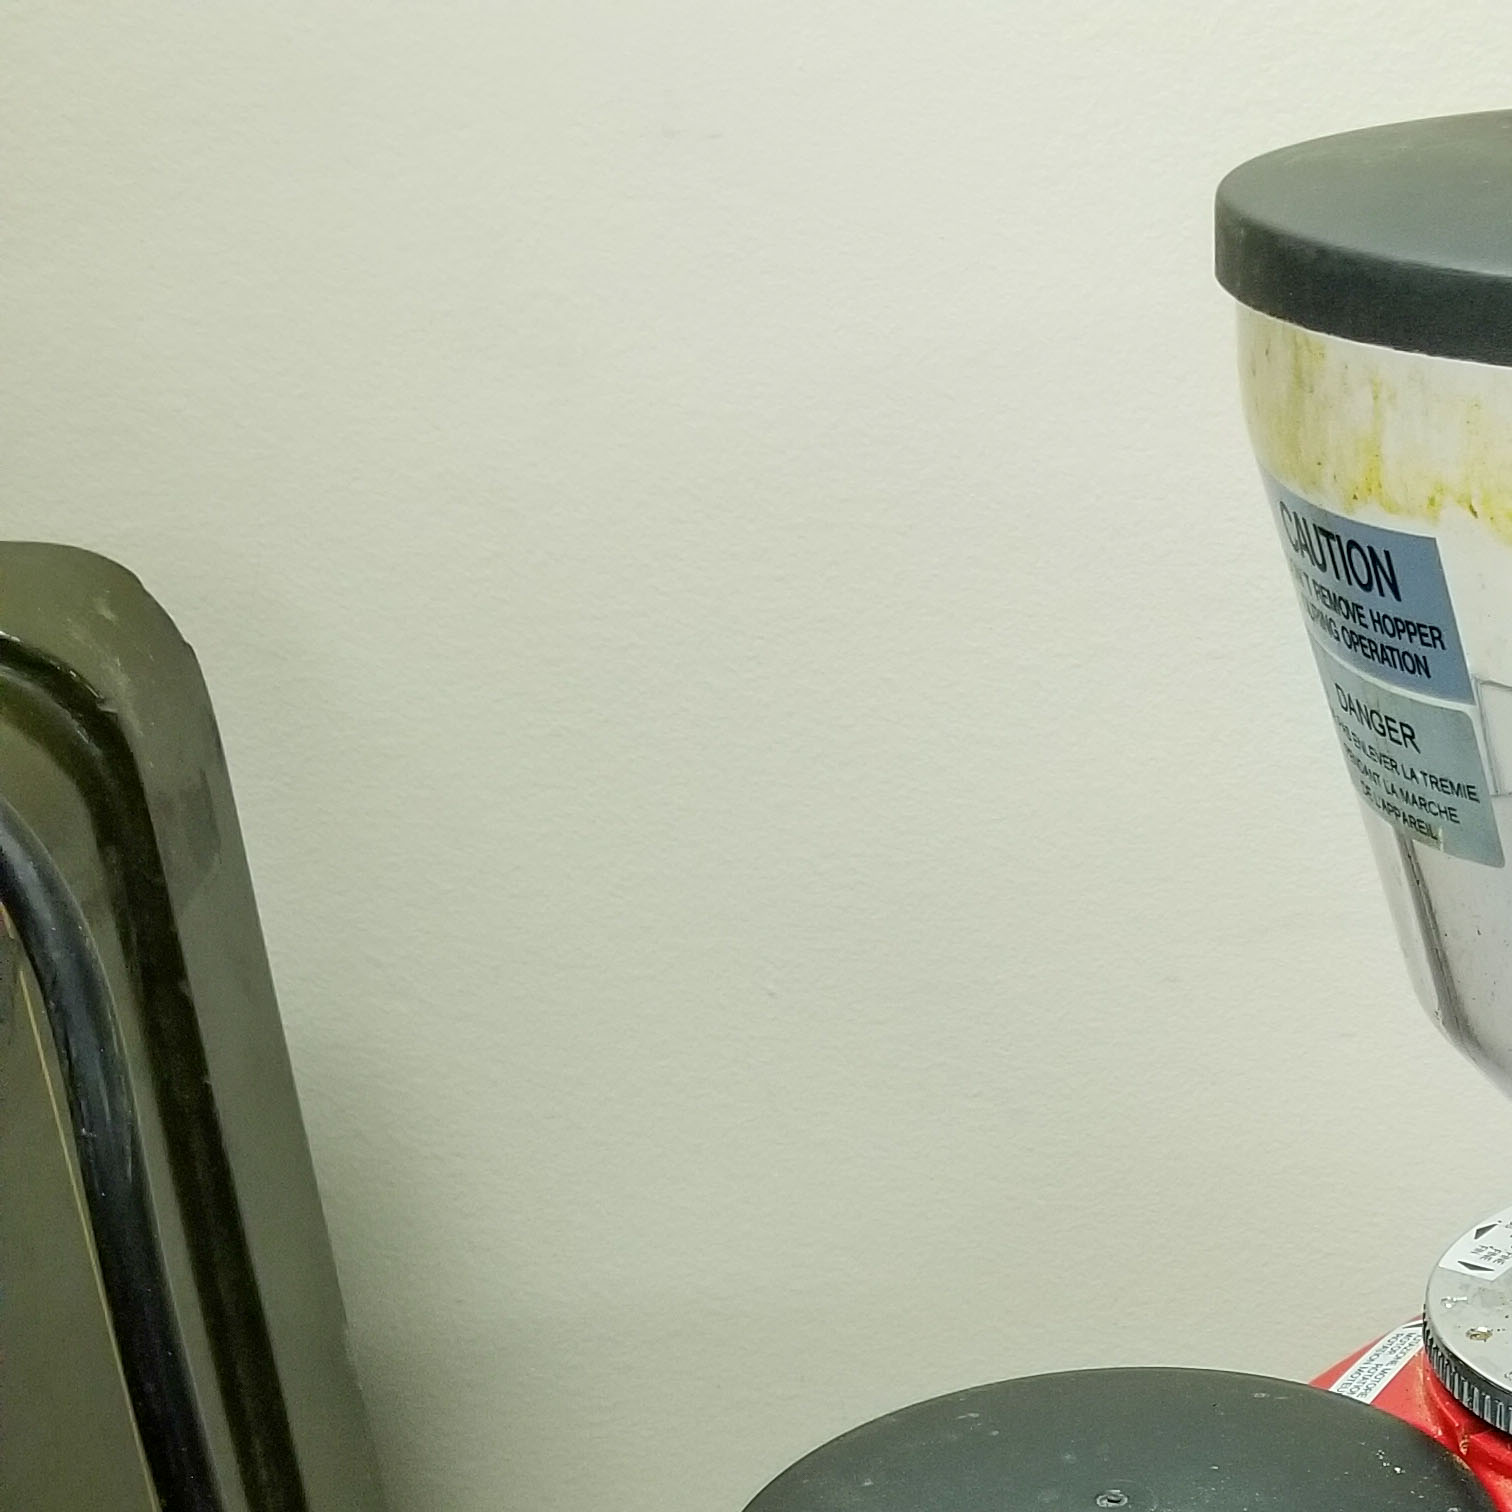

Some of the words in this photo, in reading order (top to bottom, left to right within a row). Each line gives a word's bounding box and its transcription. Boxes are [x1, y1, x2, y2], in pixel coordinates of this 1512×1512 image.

[1280, 501, 1401, 602] CAUTION
[1312, 579, 1368, 629] REMOVE
[1369, 609, 1446, 650] HOPPER
[1341, 626, 1431, 679] OPERATION
[1334, 682, 1421, 754] DANGER
[1383, 778, 1398, 798] LA
[1399, 788, 1461, 824] MARCHE
[1401, 764, 1419, 784] LA
[1420, 771, 1481, 803] TREMIE
